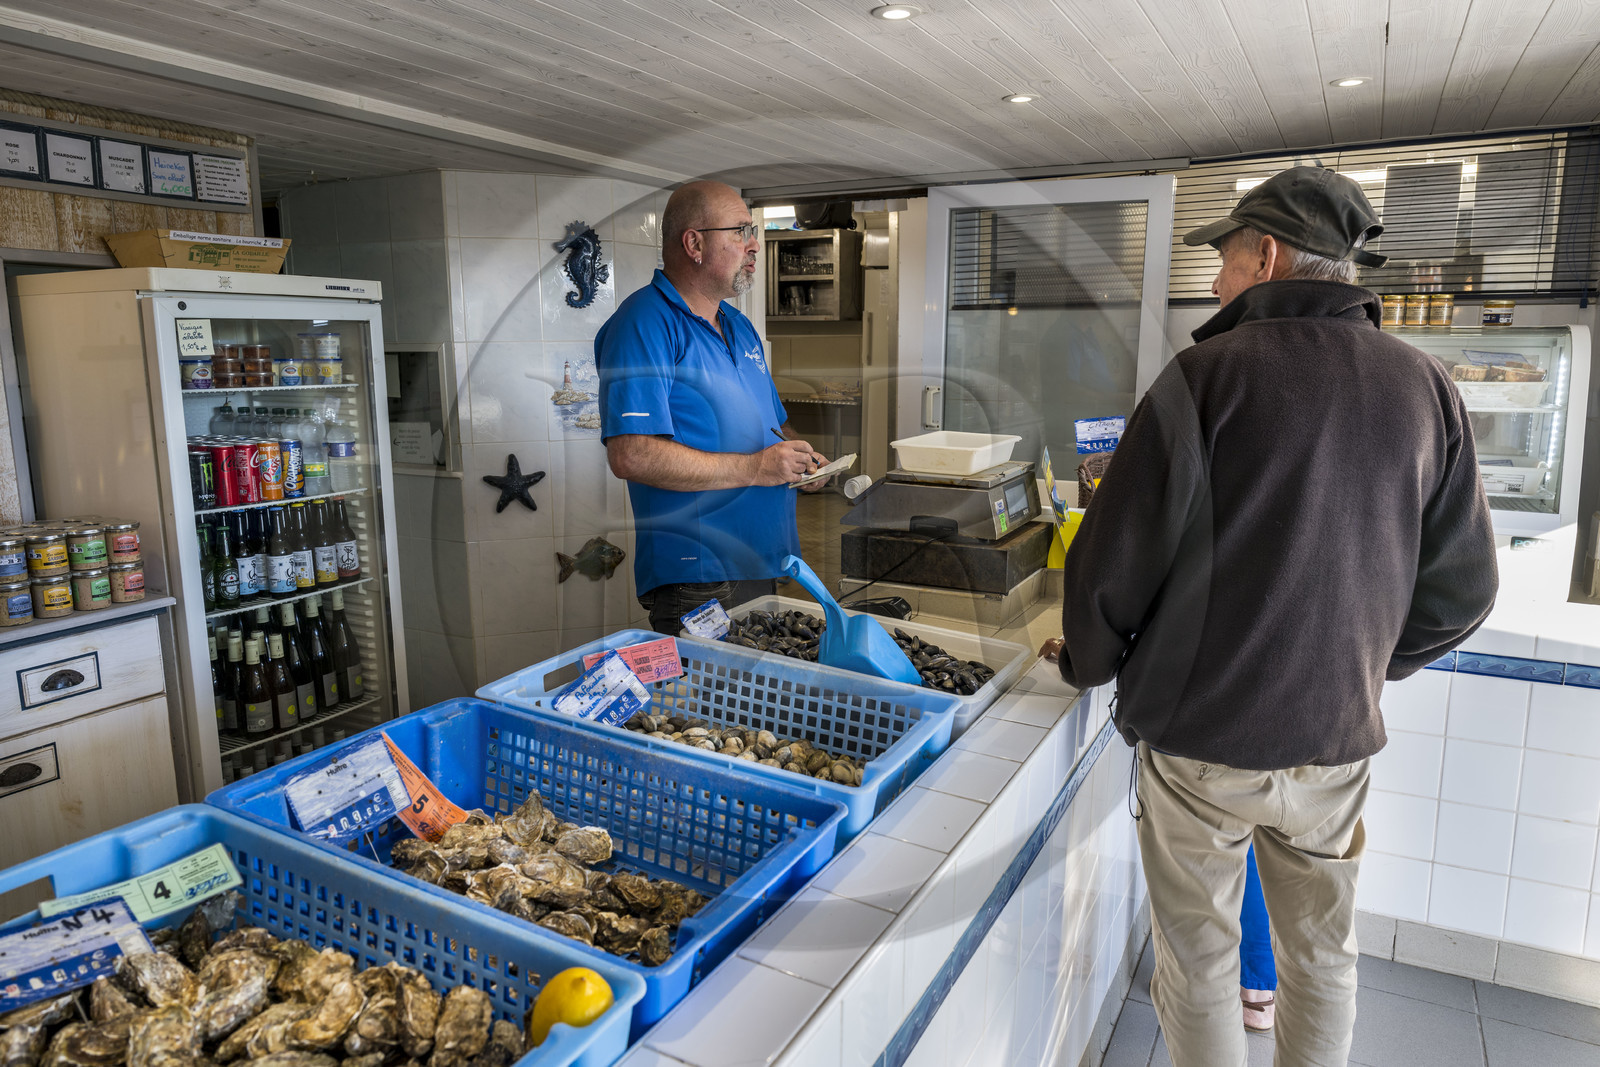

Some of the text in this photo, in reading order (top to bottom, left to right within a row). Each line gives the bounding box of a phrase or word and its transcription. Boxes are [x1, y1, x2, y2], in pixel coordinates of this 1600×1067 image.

[53, 151, 86, 161] CHARDONNAY
[108, 155, 134, 164] MUSCADET
[161, 182, 191, 195] 4,00€
[173, 231, 197, 241] Emballage
[263, 239, 268, 247] 2
[262, 454, 281, 483] Oasis
[285, 447, 301, 490] ORANGINA
[326, 763, 348, 777] Huître
[412, 794, 430, 814] 5
[153, 880, 172, 900] 4
[22, 925, 60, 940] Huître
[92, 907, 115, 924] 4
